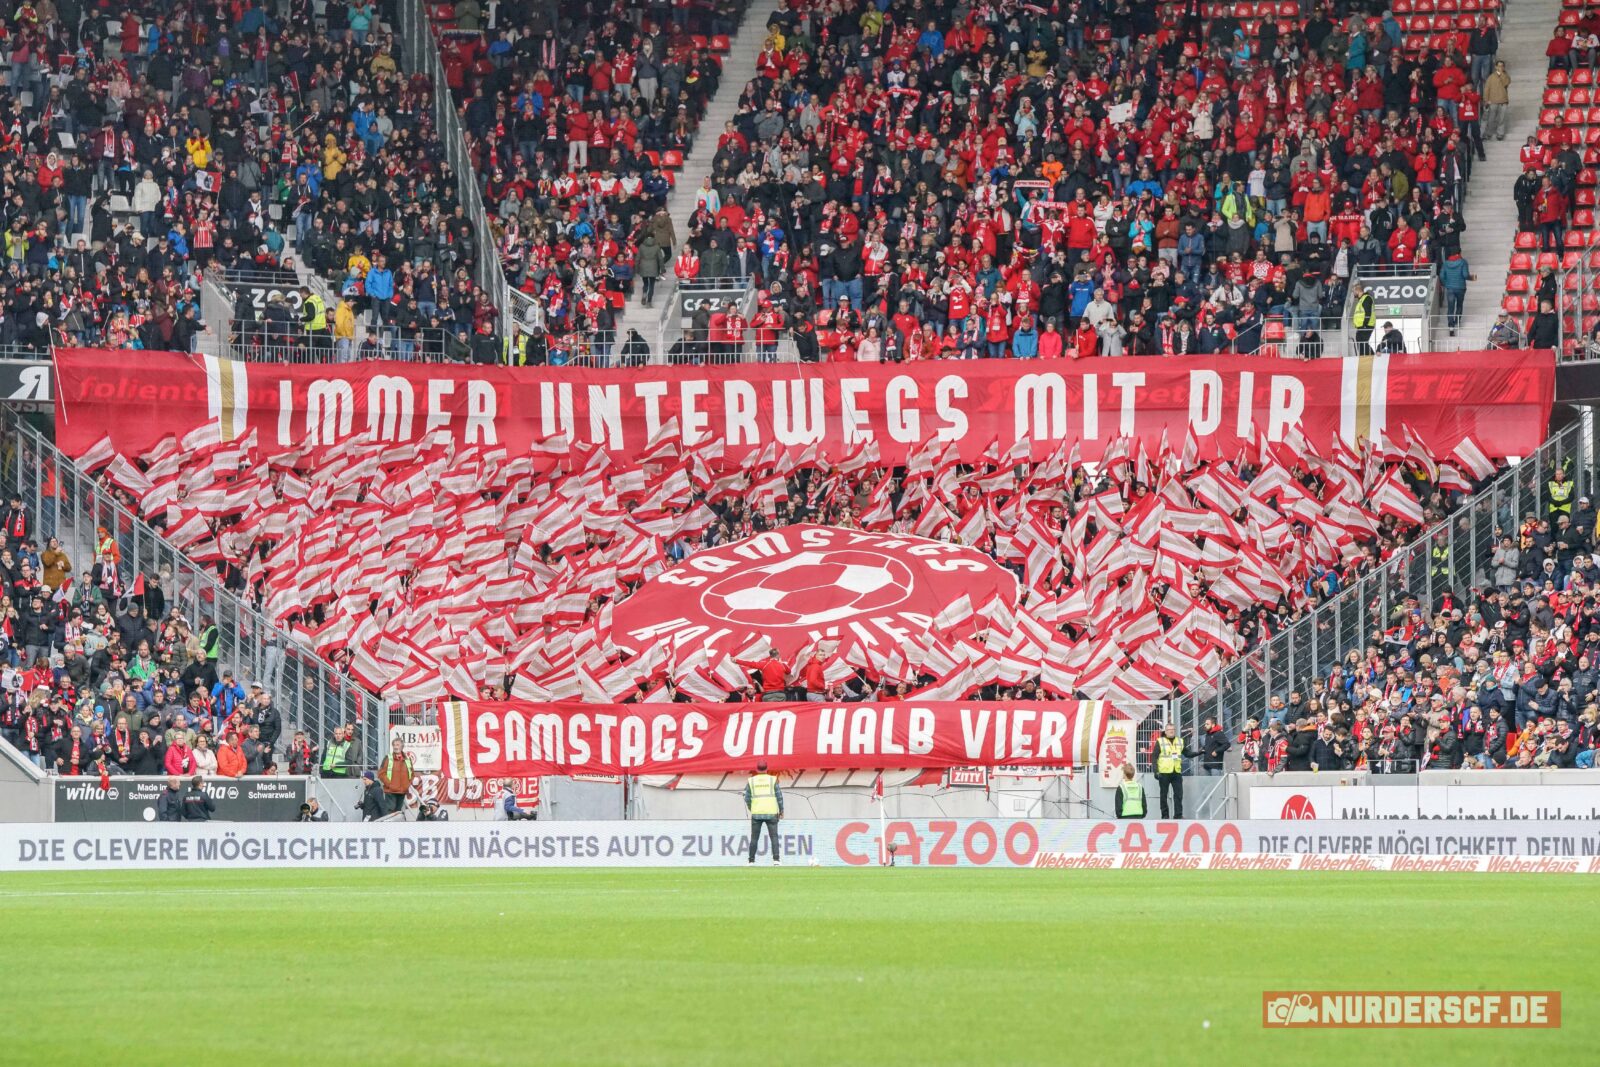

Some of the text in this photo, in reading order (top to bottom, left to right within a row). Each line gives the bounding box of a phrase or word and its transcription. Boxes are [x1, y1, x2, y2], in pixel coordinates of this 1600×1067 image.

[279, 374, 498, 446] IMMER
[541, 374, 970, 451] UNTERWEGS
[1015, 371, 1147, 441] MIT
[1189, 369, 1305, 443] DIR
[658, 529, 988, 587] SAMSTAGS
[476, 707, 1067, 768] SAMSTAGS UM HALB VIER
[954, 772, 981, 783] ZITTY
[67, 782, 106, 801] wiha
[138, 783, 158, 792] Made
[248, 791, 296, 800] Schwarzwald
[256, 783, 288, 792] Made im
[19, 838, 64, 861] DIE
[73, 837, 189, 861] CLEVERE
[197, 831, 390, 863] MÖGLICHKEIT,
[399, 837, 460, 859] DEIN
[469, 830, 600, 858] NÄCHSTES
[606, 835, 674, 858] AUTO
[682, 835, 713, 857] ZU
[836, 821, 1243, 865] CAZOO CAZOO
[1259, 835, 1290, 853] DIE
[1294, 835, 1373, 854] CLEVERE
[1527, 836, 1575, 856] DEIN
[1581, 831, 1600, 856] N
[1035, 852, 1115, 869] WeberHaus
[1120, 852, 1203, 870] WeberHaus
[1208, 853, 1293, 870] WeberHaus
[1299, 854, 1376, 871] WeberHau
[1390, 855, 1480, 872] WeberHaus
[1487, 855, 1580, 873] WeberHaus
